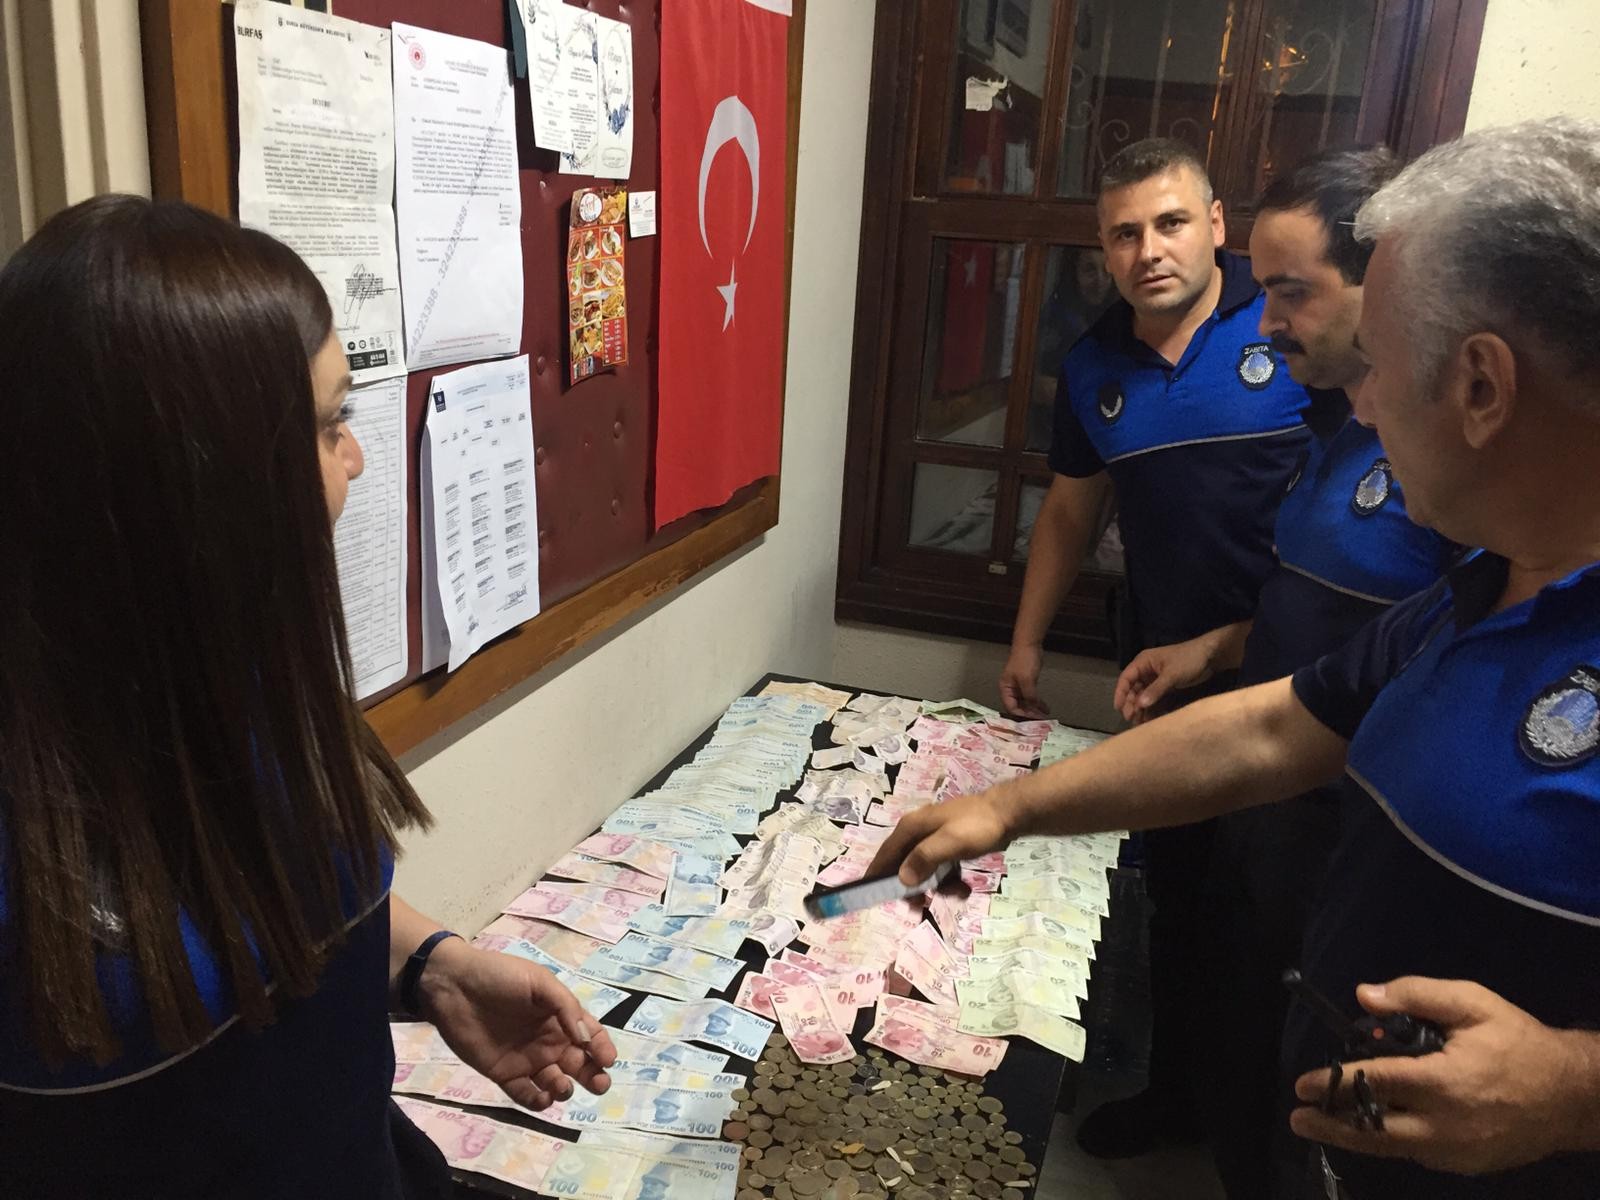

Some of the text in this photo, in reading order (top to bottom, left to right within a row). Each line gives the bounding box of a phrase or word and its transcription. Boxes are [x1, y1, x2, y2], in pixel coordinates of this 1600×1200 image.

[1244, 345, 1269, 355] ZABITA
[1018, 744, 1032, 752] 10
[994, 756, 1007, 765] 10
[737, 808, 757, 816] 100
[1090, 903, 1105, 913] 20
[729, 919, 751, 928] 100
[627, 934, 651, 944] 100
[520, 941, 542, 957] 100
[717, 957, 740, 967] 100
[1062, 959, 1078, 968] 20
[899, 965, 914, 981] 10
[856, 973, 874, 984] 10
[600, 987, 624, 998] 100
[774, 990, 788, 1003] 10
[838, 991, 855, 1004] 10
[968, 1001, 987, 1009] 20
[632, 1020, 656, 1034] 100
[755, 1019, 771, 1030] 100
[732, 1040, 758, 1058] 100
[973, 1044, 993, 1057] 10
[706, 1054, 724, 1064] 100
[713, 1075, 740, 1085] 100
[443, 1086, 472, 1100] 200
[704, 1091, 723, 1099] 100
[436, 1111, 466, 1121] 200
[568, 1110, 597, 1123] 100
[687, 1122, 716, 1135] 100
[718, 1144, 737, 1154] 100
[714, 1162, 735, 1172] 100
[698, 1169, 718, 1180] 100
[549, 1179, 579, 1195] 100
